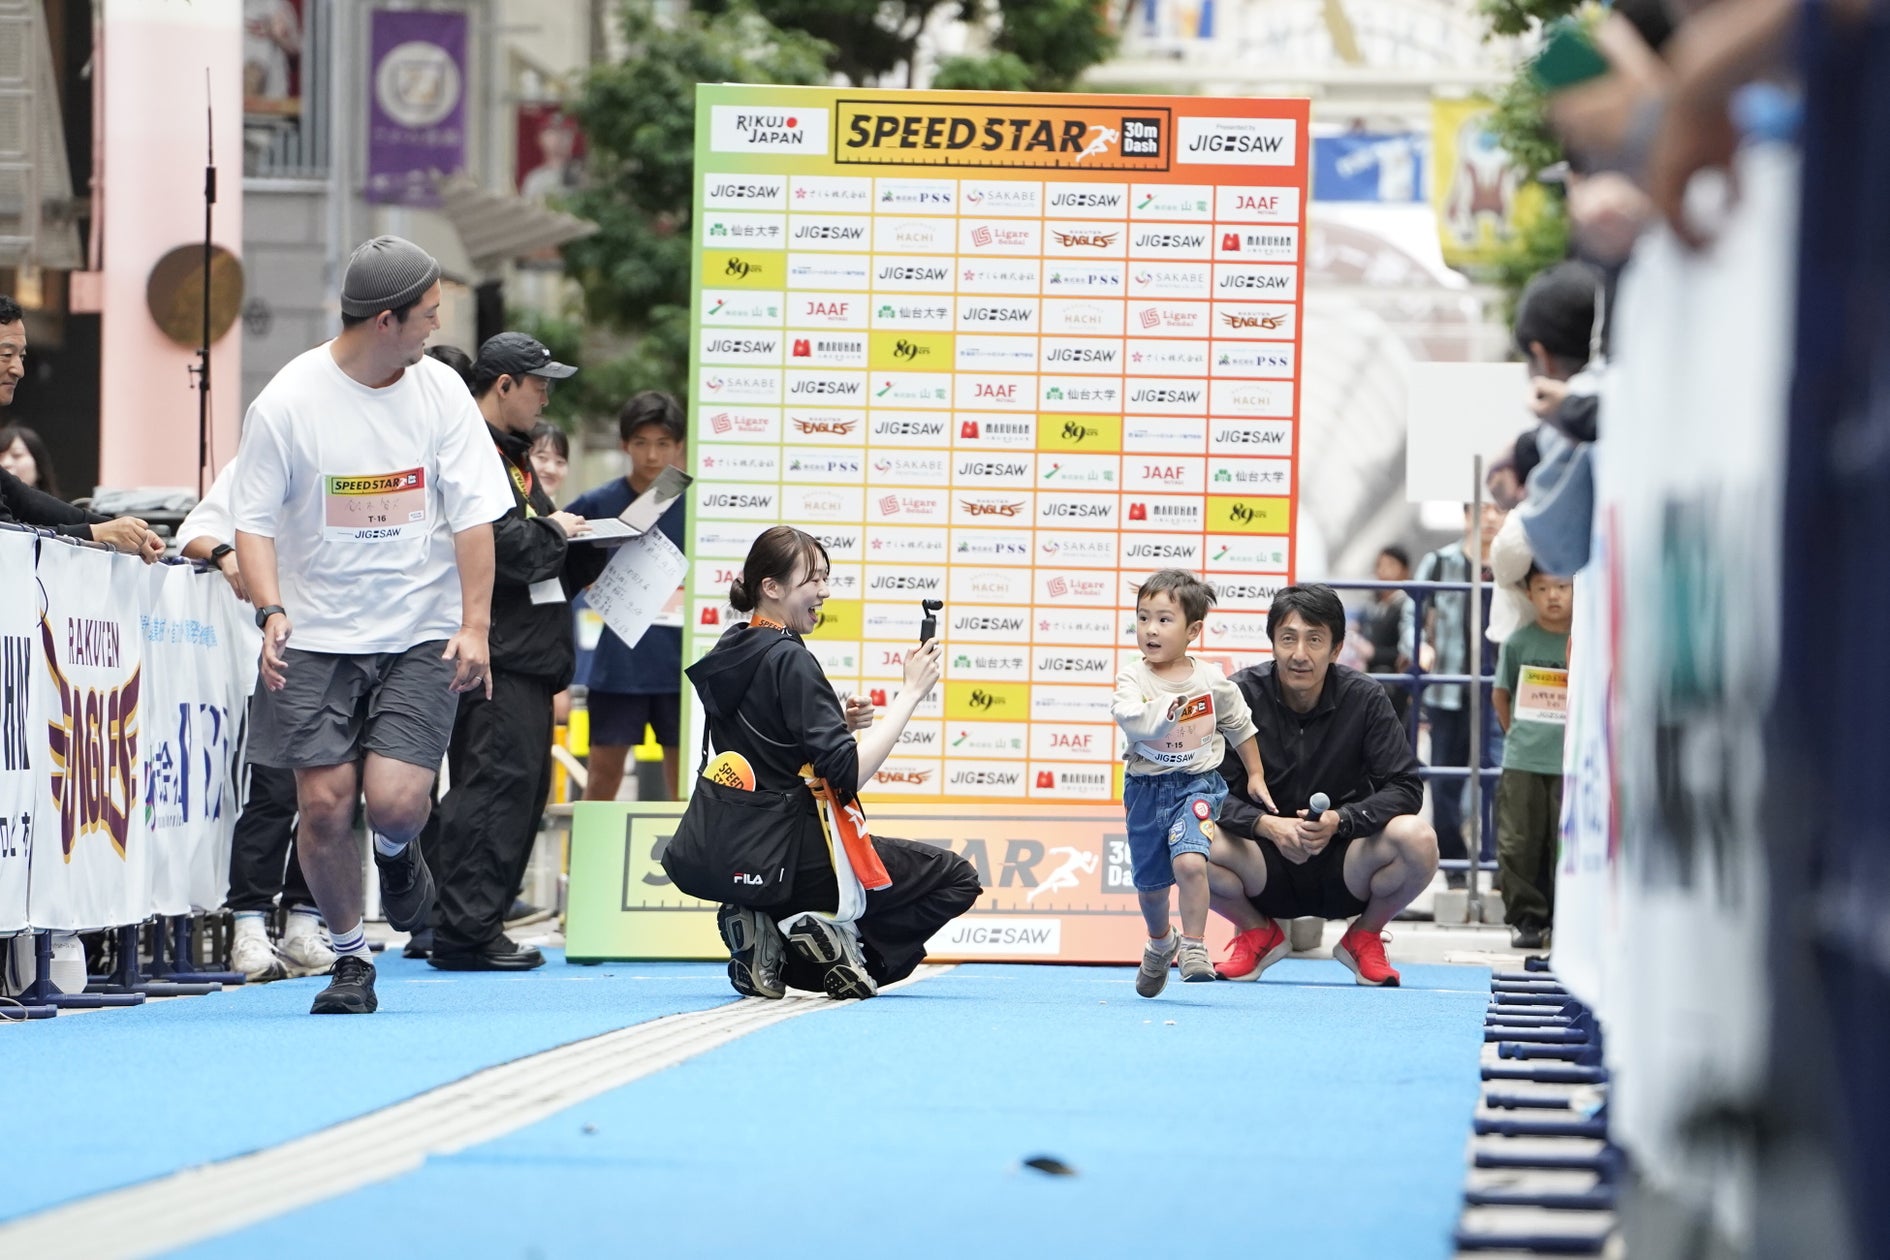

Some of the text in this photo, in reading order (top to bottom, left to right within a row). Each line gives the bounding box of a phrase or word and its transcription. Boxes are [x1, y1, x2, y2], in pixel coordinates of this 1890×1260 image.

[748, 127, 804, 145] JAPAN
[846, 113, 1089, 154] SPEED STAR
[1124, 121, 1158, 139] 30m
[1124, 138, 1158, 154] Dash
[986, 190, 1037, 201] SAKABE
[1235, 195, 1279, 210] JAAF
[730, 224, 780, 238] 仙台大学
[895, 232, 934, 242] HACHI
[994, 228, 1029, 240] Ligare
[1060, 233, 1109, 248] EAGLES
[1246, 235, 1291, 247] MARUHAN
[1154, 272, 1205, 282] SAKABE
[805, 301, 849, 316] JAAF
[898, 306, 948, 320] 仙台大学
[1063, 313, 1103, 323] HACHI
[1162, 310, 1197, 322] Ligare
[1229, 315, 1278, 330] EAGLES
[816, 341, 861, 353] MARUHAN
[725, 377, 776, 388] SAKABE
[973, 383, 1017, 398] JAAF
[1066, 388, 1116, 402] 仙台大学
[1232, 395, 1271, 405] HACHI
[734, 415, 769, 427] Ligare
[801, 420, 849, 435] EAGLES
[984, 422, 1029, 434] MARUHAN
[894, 459, 944, 469] SAKABE
[1141, 465, 1185, 480] JAAF
[1235, 470, 1285, 484] 仙台大学
[335, 479, 371, 491] SPEED
[372, 477, 401, 490] STAR
[803, 501, 842, 511] HACHI
[902, 497, 937, 509] Ligare
[968, 502, 1016, 517] EAGLES
[1153, 504, 1198, 516] MARUHAN
[367, 514, 387, 523] T-16
[1062, 541, 1113, 552] SAKABE
[971, 582, 1010, 592] HACHI
[1070, 579, 1105, 590] Ligare
[1232, 623, 1264, 633] SAKA
[68, 616, 120, 668] RAKUTEN
[974, 656, 1024, 669] 仙台大学
[1049, 733, 1093, 747] JAAF
[1166, 741, 1184, 749] T-15
[51, 680, 140, 864] EAGLES
[1060, 772, 1105, 784] MARUHAN
[733, 871, 764, 885] FILA
